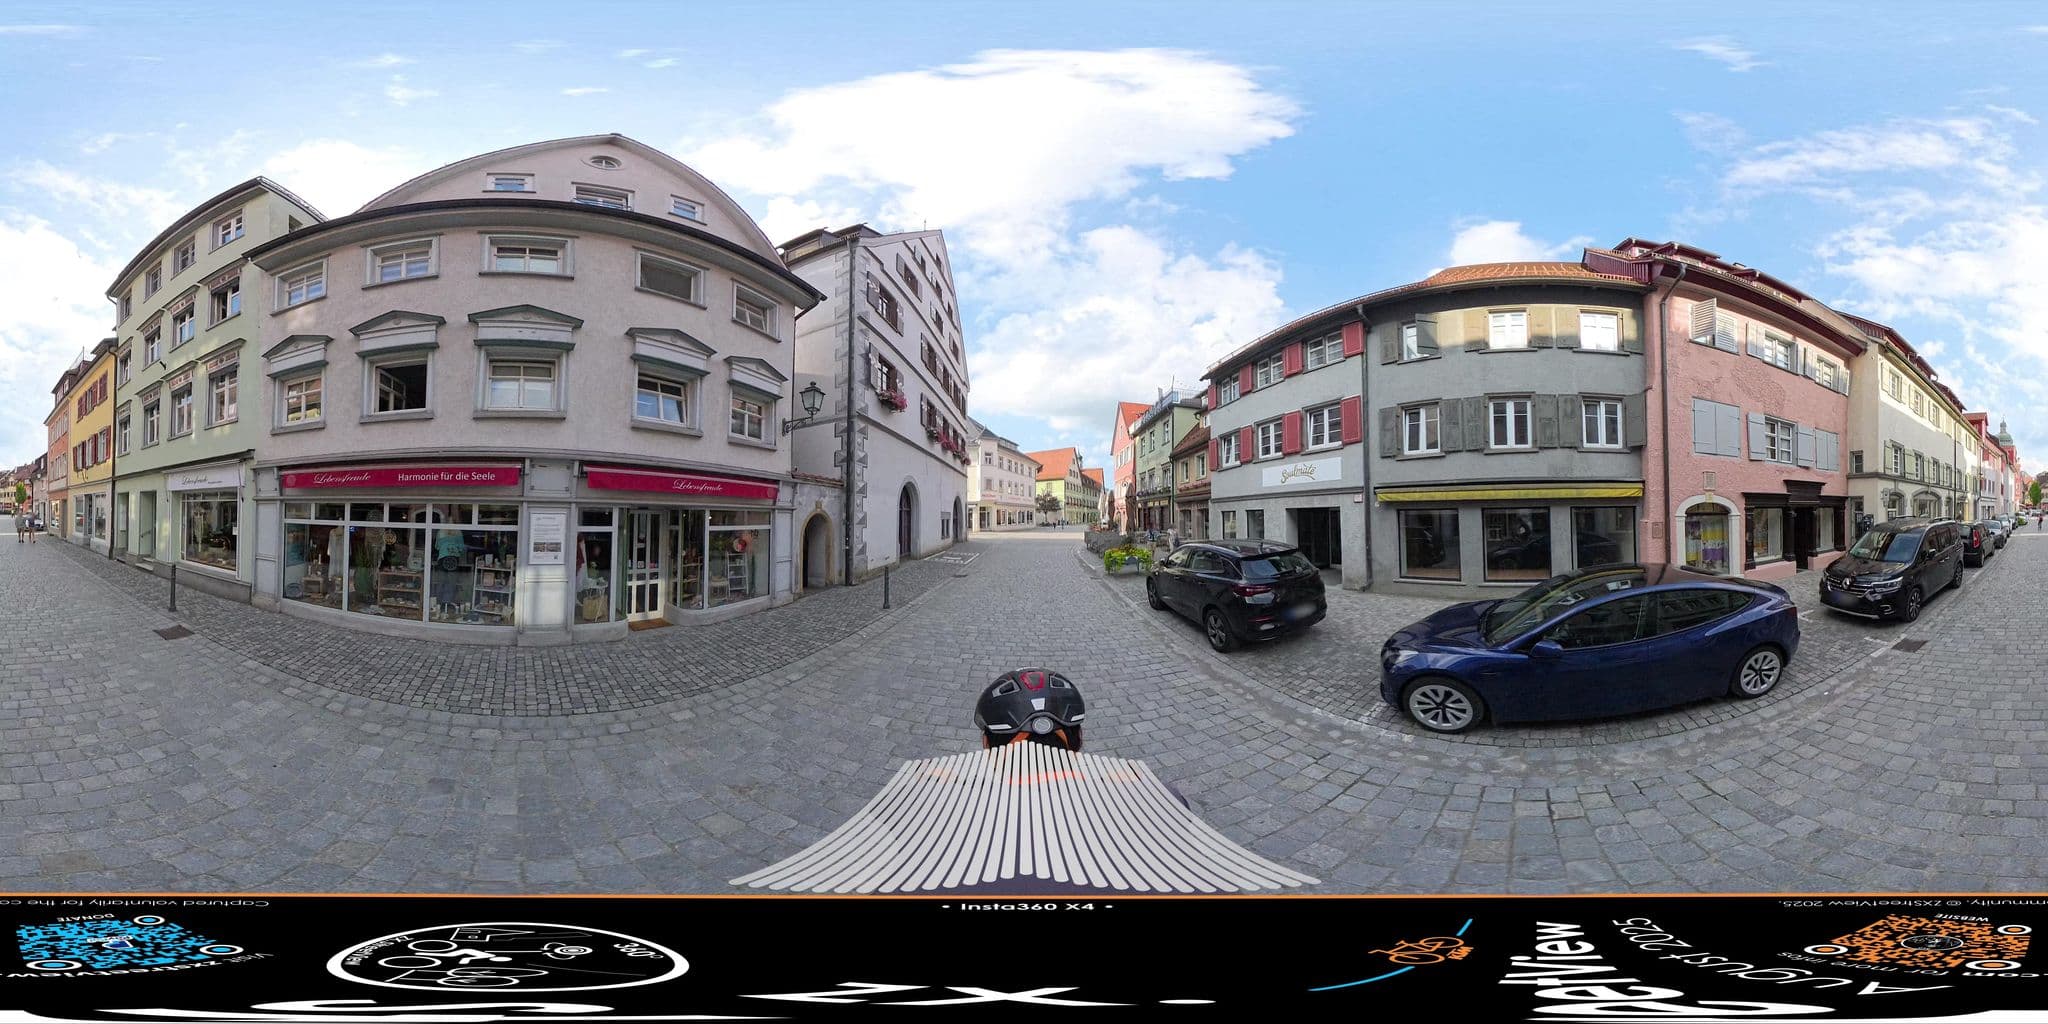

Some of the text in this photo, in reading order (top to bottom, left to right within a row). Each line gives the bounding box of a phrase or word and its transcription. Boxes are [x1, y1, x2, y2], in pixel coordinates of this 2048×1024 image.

[313, 473, 371, 484] Lebensfreude
[398, 471, 496, 481] Harmonie für die Seele
[672, 479, 723, 492] Lebensfreude
